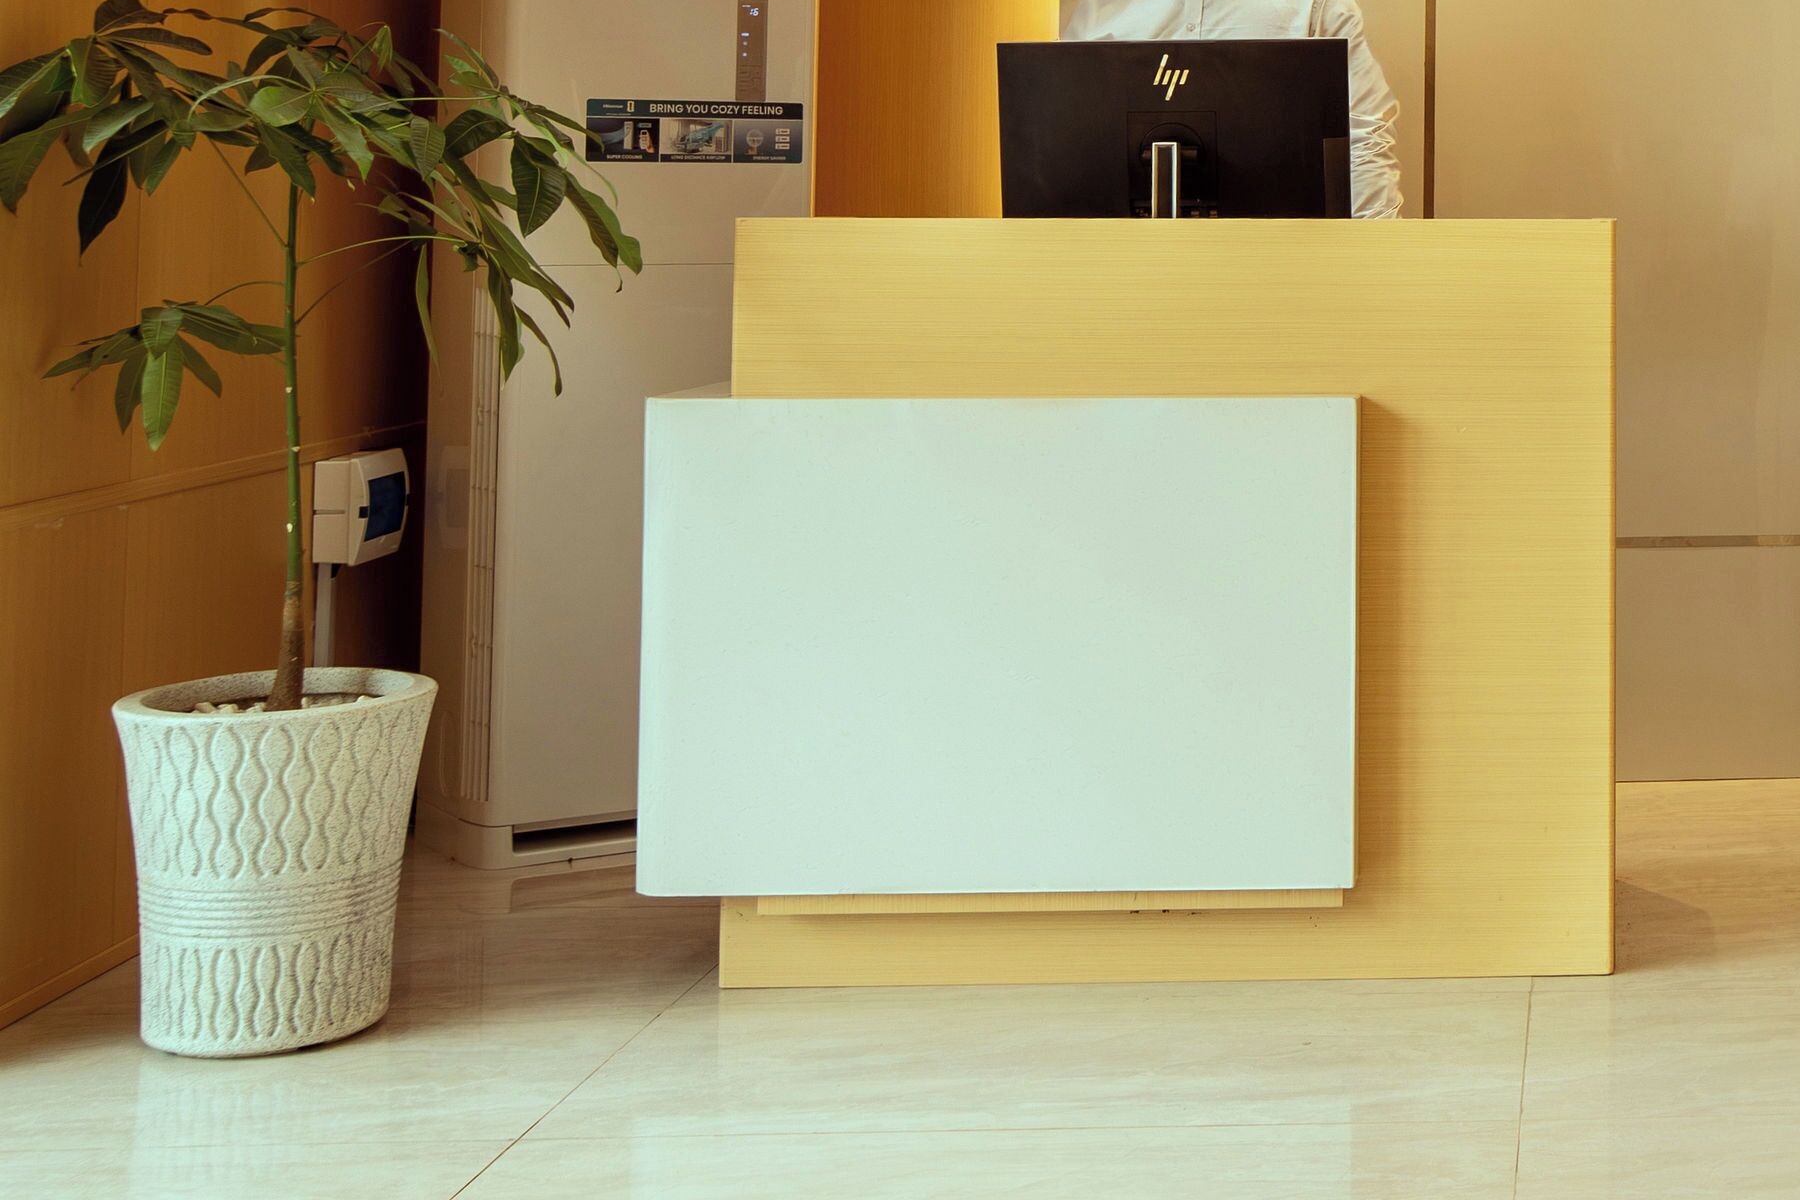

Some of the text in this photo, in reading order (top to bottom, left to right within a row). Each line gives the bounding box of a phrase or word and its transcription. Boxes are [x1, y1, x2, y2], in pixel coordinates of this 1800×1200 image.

[1153, 53, 1190, 101] hp
[649, 103, 784, 116] BRING YOU COZY FEELING
